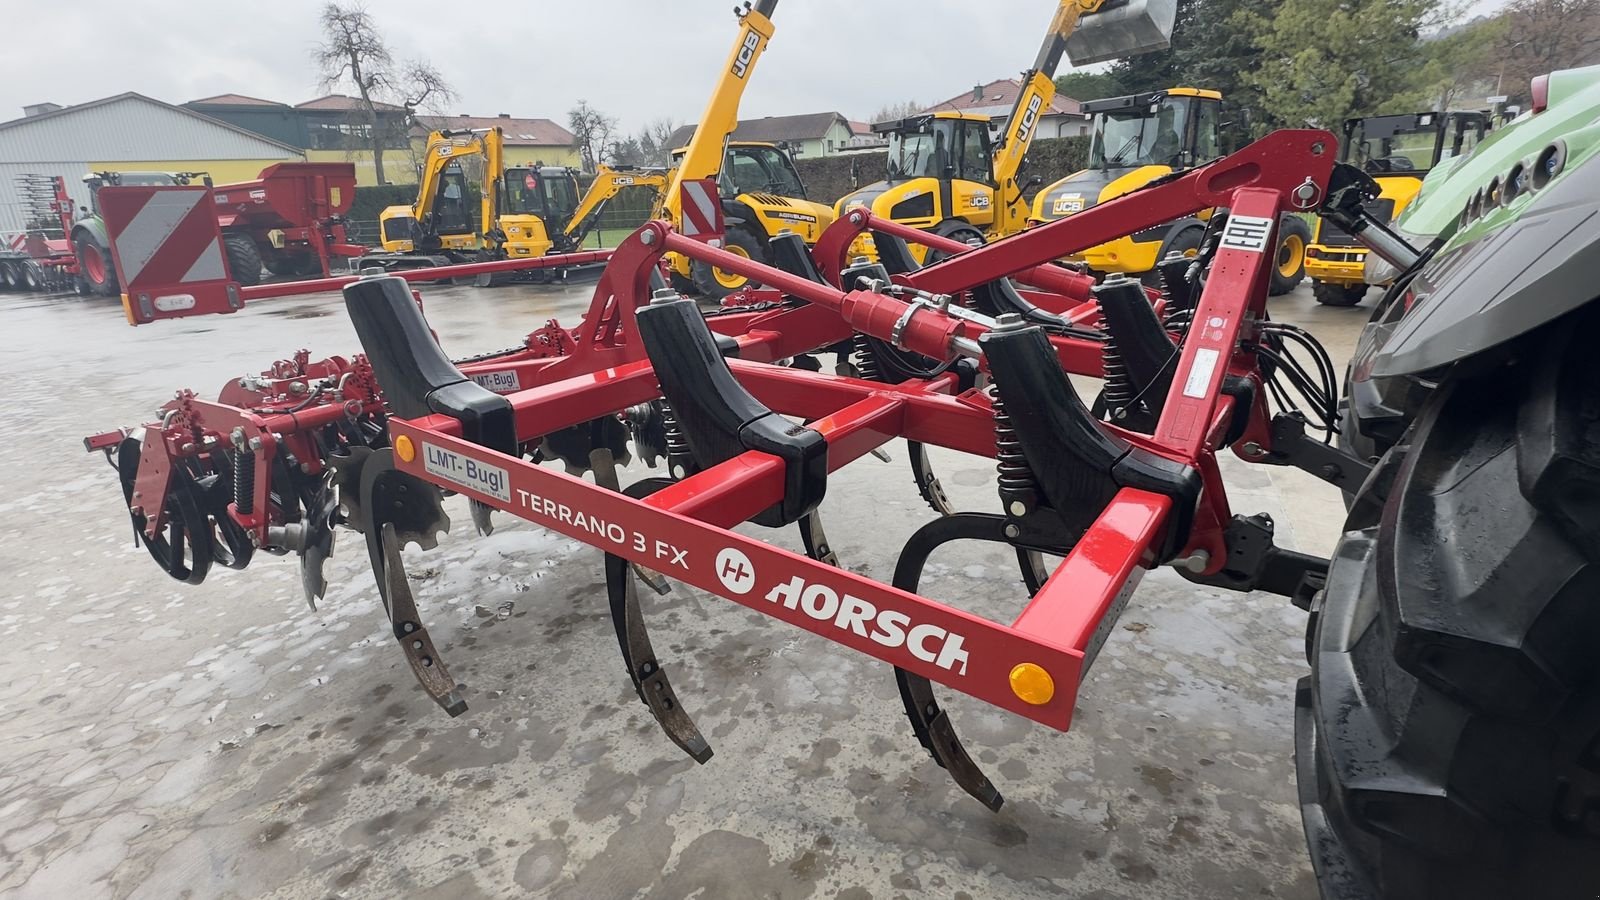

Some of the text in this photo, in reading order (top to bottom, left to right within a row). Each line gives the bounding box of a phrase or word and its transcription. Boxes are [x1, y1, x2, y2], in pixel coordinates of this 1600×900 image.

[734, 30, 761, 78] JCB
[1020, 94, 1043, 142] JCB
[438, 147, 452, 156] JCB
[612, 177, 634, 185] JCB
[970, 197, 990, 208] JCB
[1055, 202, 1081, 212] JCB
[517, 489, 690, 570] TERRANO 3 FX
[765, 575, 969, 676] HORSCH
